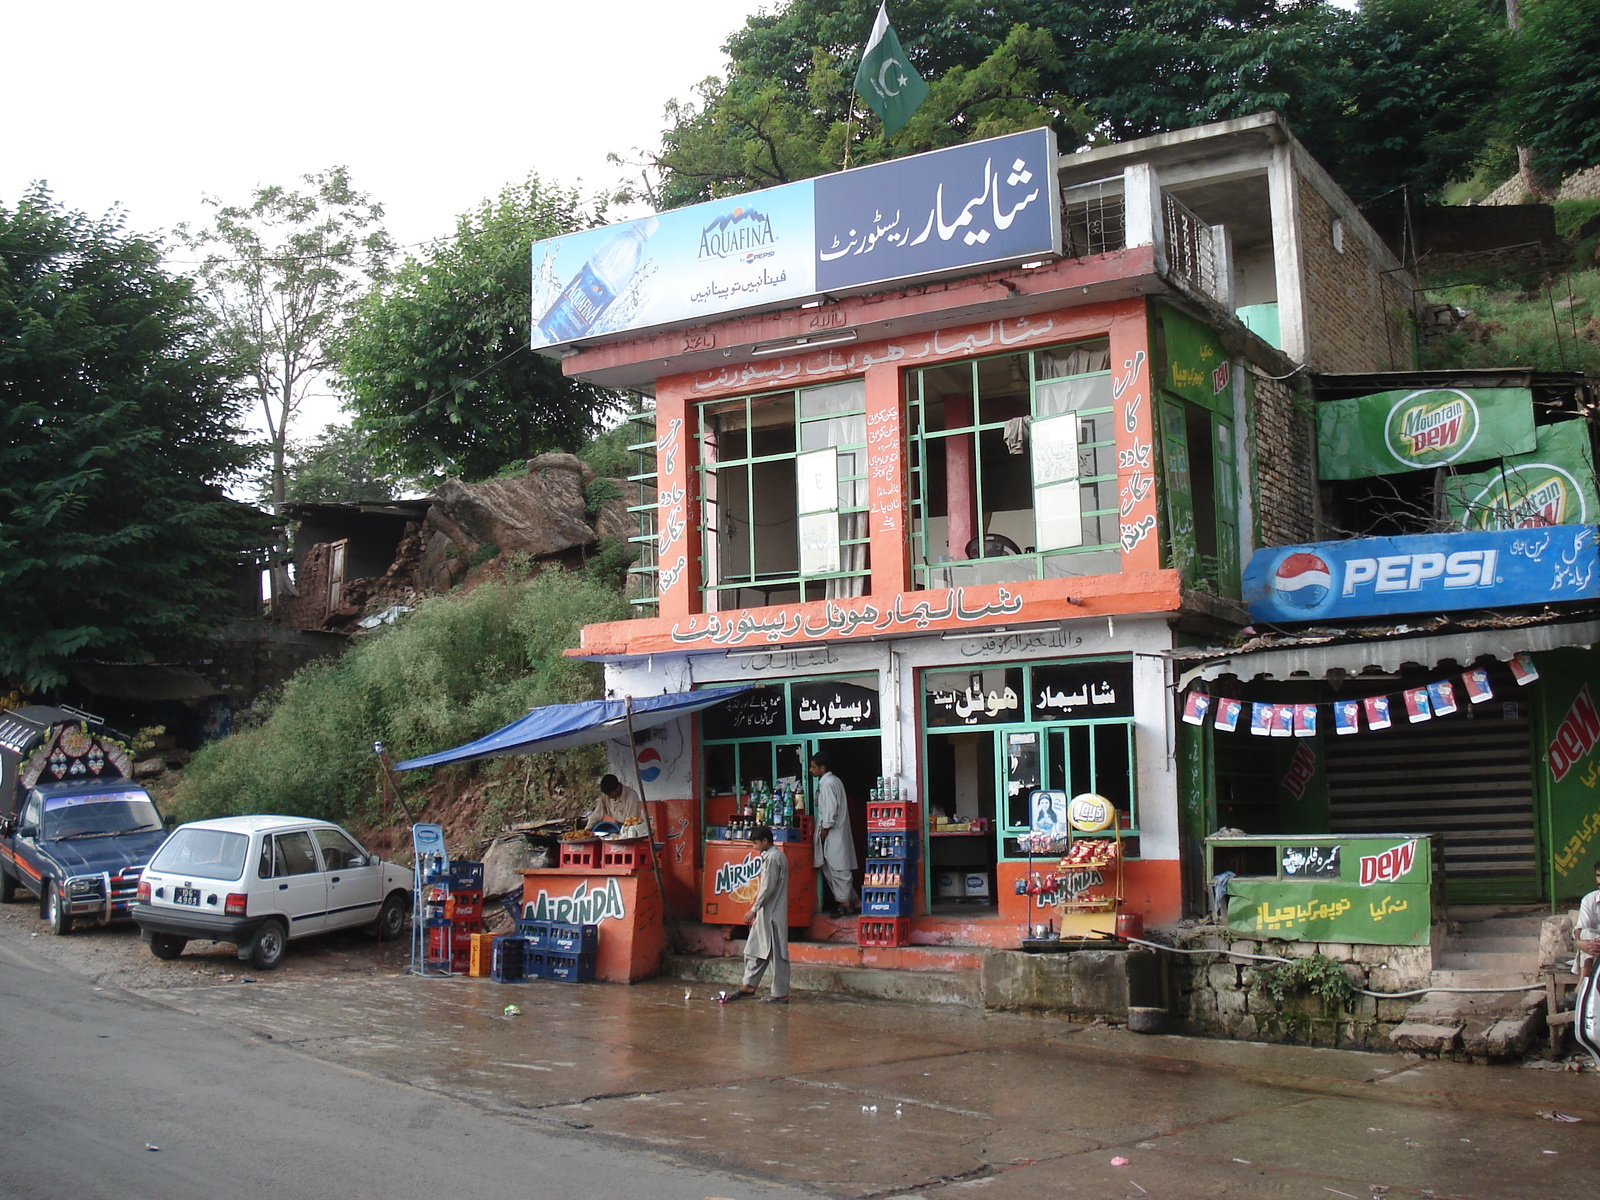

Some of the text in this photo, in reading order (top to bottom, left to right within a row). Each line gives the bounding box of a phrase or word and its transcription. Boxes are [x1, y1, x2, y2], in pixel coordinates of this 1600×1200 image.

[819, 157, 1039, 262] شالیمار ریسٹورنٹ
[698, 212, 775, 259] AQUAFINA
[753, 251, 775, 260] PEPSI
[565, 278, 604, 325] AQUAFINA
[909, 316, 1054, 358] شالیمار
[1404, 401, 1462, 438] Mountain
[1341, 549, 1499, 598] PEPSI
[671, 609, 801, 643] ریسٹورنٹ
[882, 586, 1024, 629] شالیمار
[799, 692, 871, 725] ریسٹورنٹ
[1035, 681, 1116, 713] شالیمار
